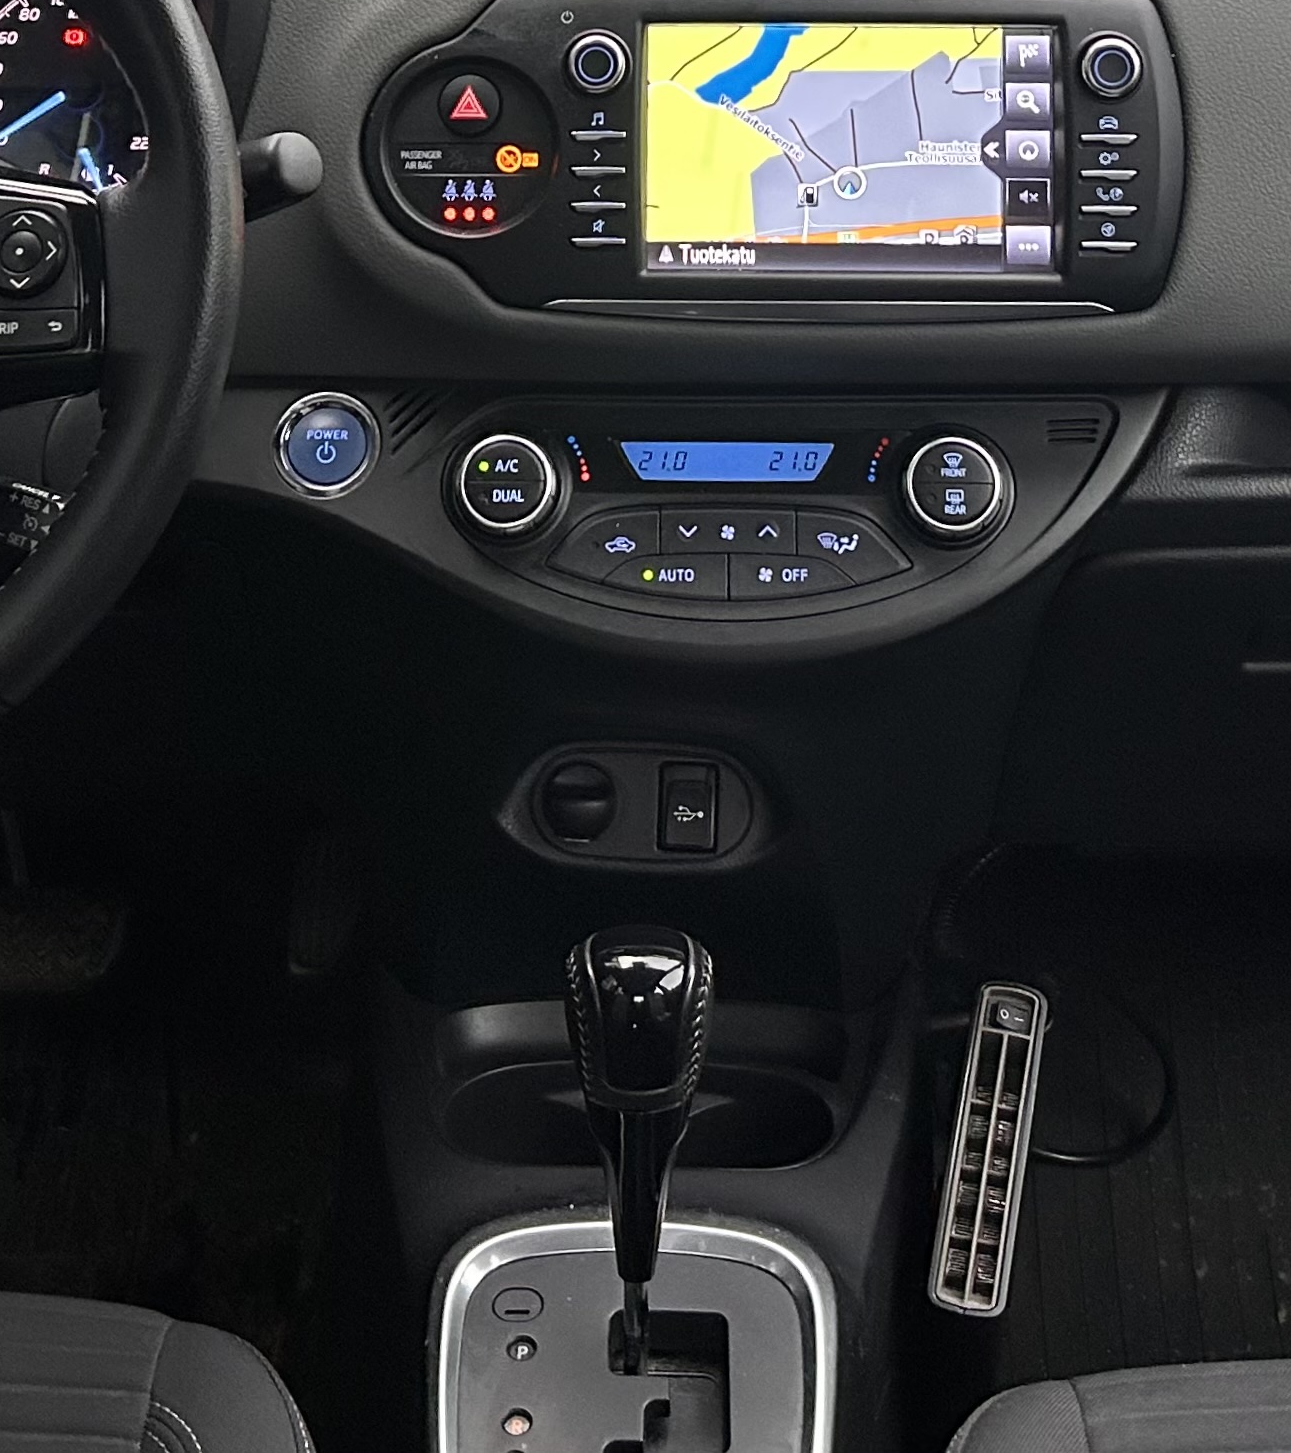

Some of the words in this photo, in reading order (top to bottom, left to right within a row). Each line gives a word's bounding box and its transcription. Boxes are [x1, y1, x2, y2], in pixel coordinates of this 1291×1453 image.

[18, 7, 40, 21] 80
[720, 94, 804, 160] Vesilaitoksentie
[400, 150, 443, 160] PASSENGER
[405, 160, 417, 170] AIR
[418, 160, 433, 170] BAG
[680, 244, 756, 265] Tuotekatu
[306, 429, 349, 441] POWER
[495, 458, 519, 473] A/C
[639, 450, 688, 472] 21.0
[769, 450, 819, 472] 21.0
[940, 466, 967, 478] FRONT
[493, 489, 525, 503] DUAL
[944, 503, 967, 515] REAR
[658, 568, 695, 582] AUTO
[781, 568, 808, 582] OFF
[517, 1345, 529, 1360] P
